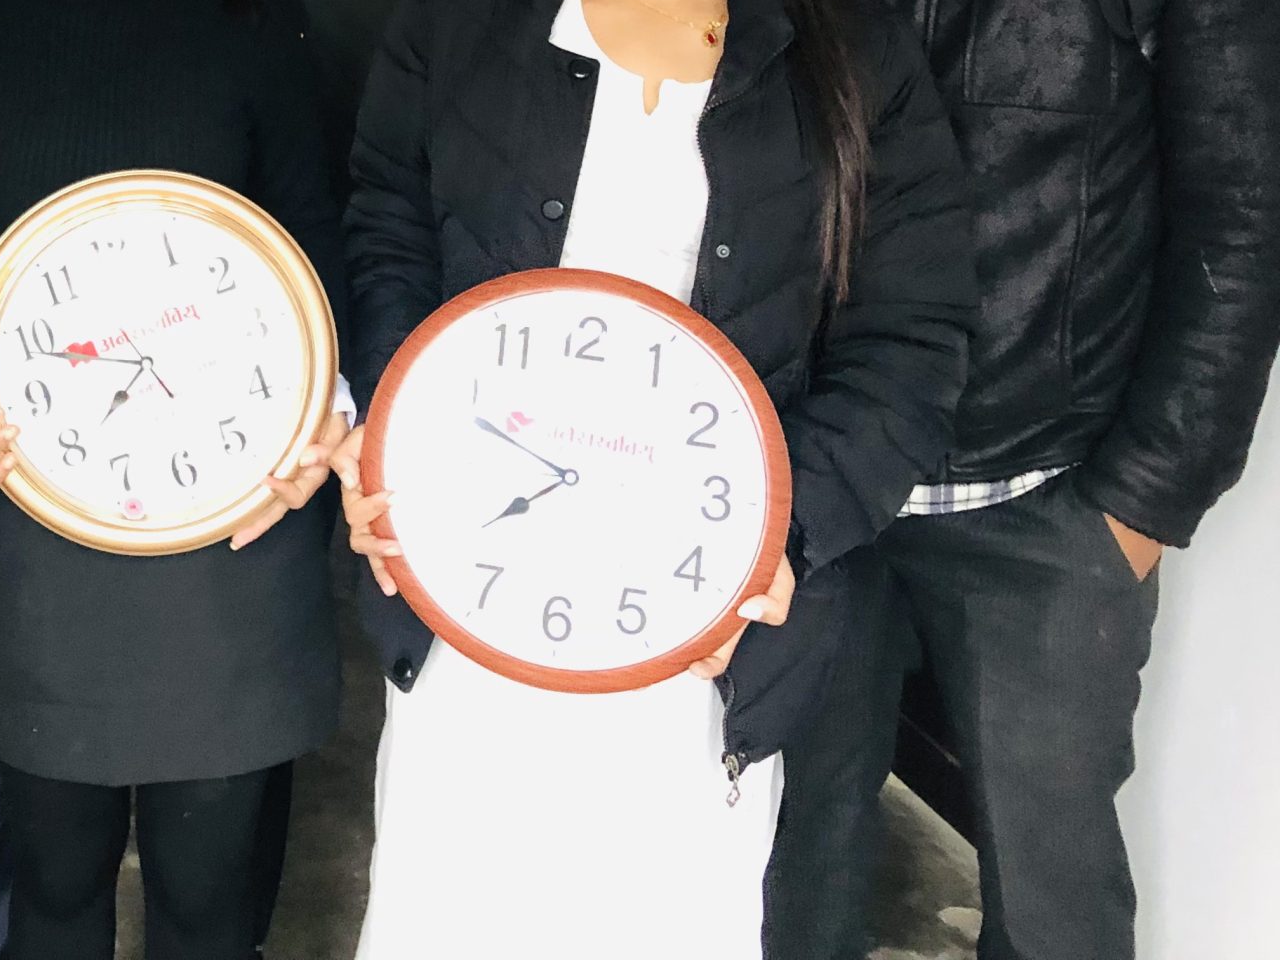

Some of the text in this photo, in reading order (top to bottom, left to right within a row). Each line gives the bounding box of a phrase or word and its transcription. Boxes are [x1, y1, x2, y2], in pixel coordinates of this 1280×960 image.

[41, 263, 79, 307] 11
[208, 256, 237, 295] 2
[14, 318, 55, 362] 10
[494, 324, 531, 370] 11
[564, 316, 608, 362] 12
[249, 364, 273, 401] 4
[648, 343, 662, 389] 1
[24, 379, 52, 417] 9
[58, 428, 87, 467] 8
[218, 416, 247, 455] 5
[685, 401, 719, 449] 2
[109, 453, 131, 492] 7
[170, 450, 198, 488] 6
[701, 475, 732, 522] 3
[475, 563, 505, 610] 7
[672, 545, 707, 592] 4
[542, 596, 573, 642] 6
[616, 587, 648, 635] 5
